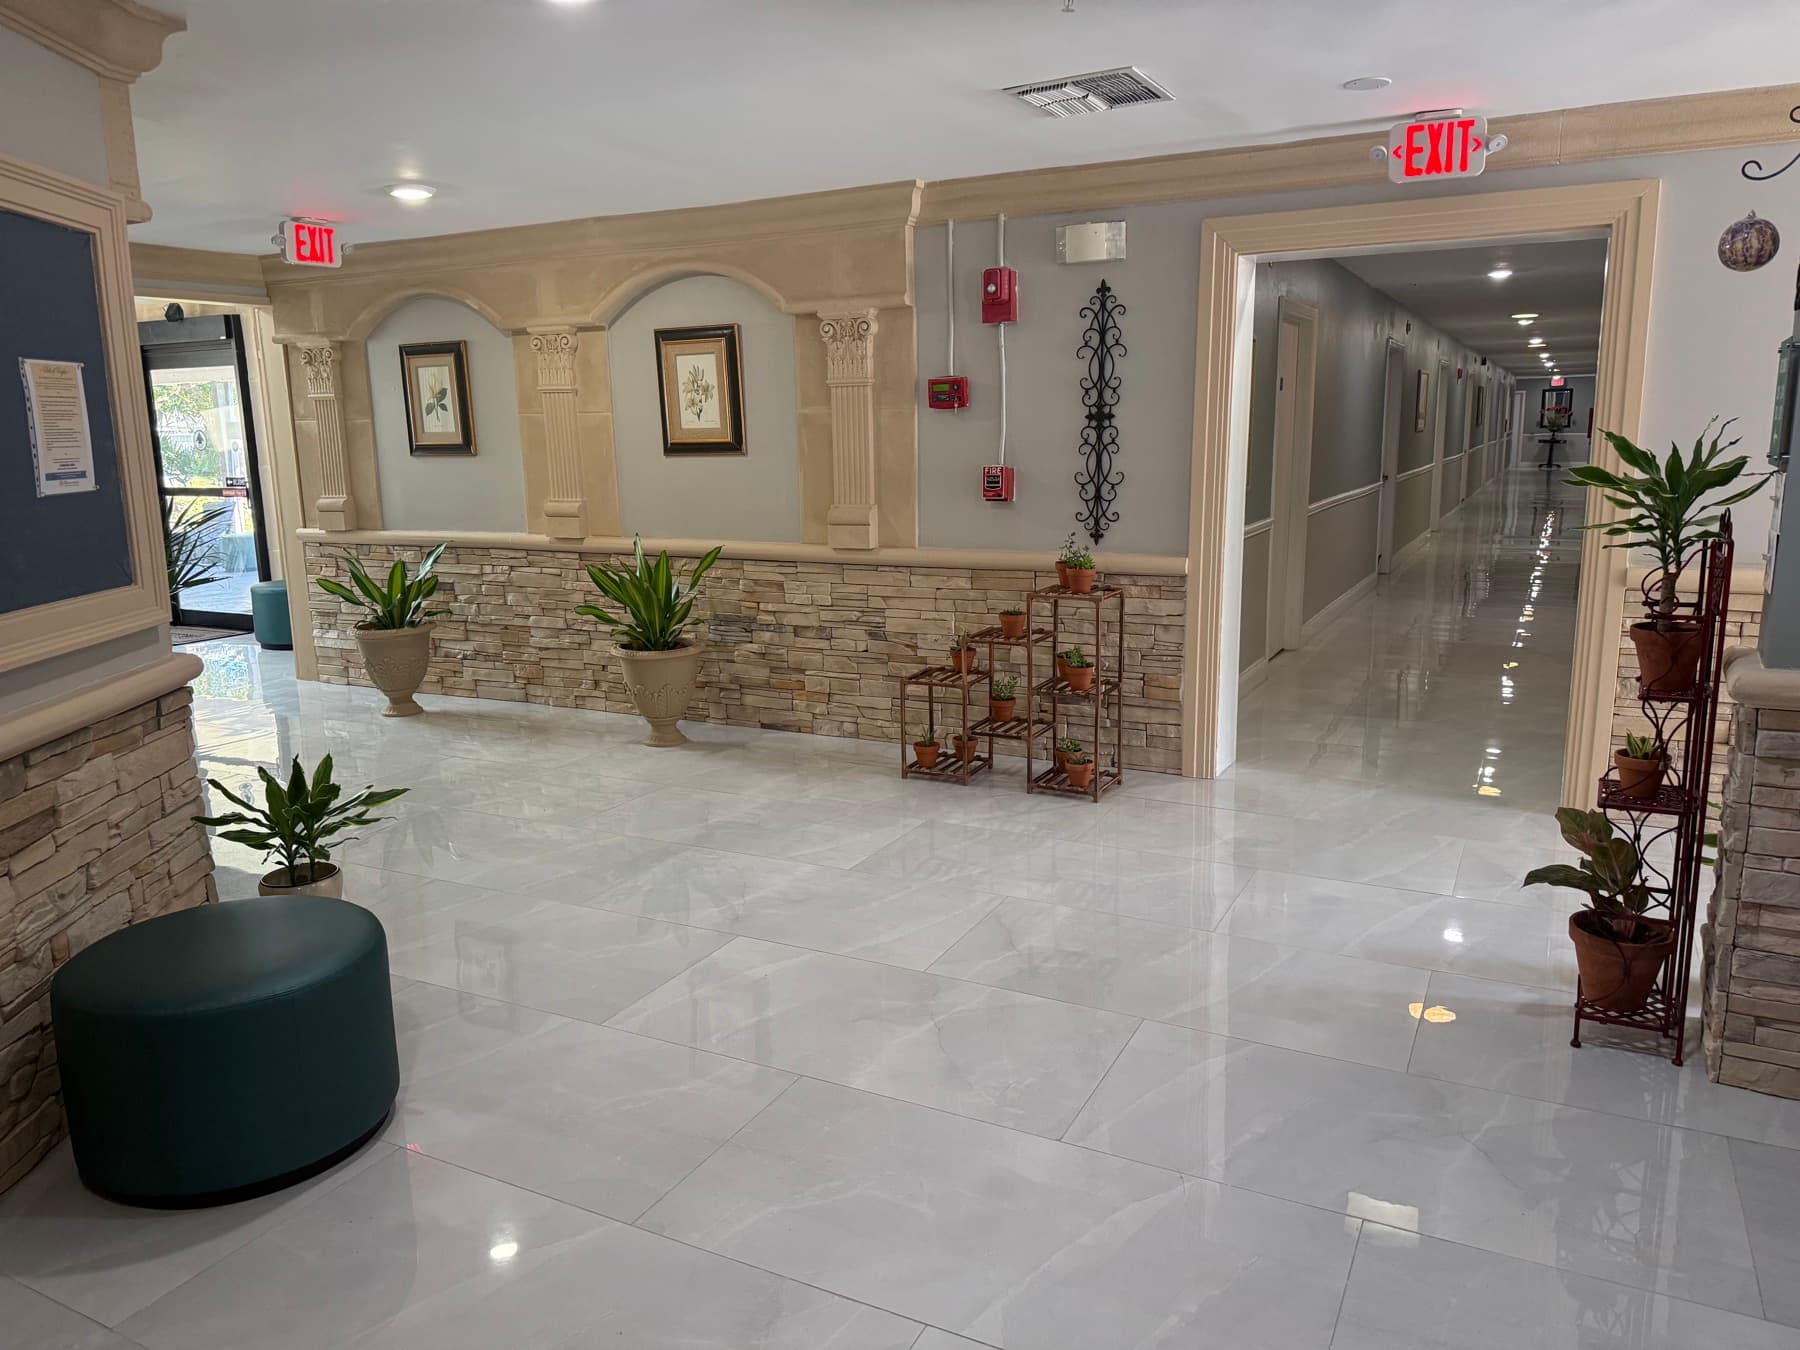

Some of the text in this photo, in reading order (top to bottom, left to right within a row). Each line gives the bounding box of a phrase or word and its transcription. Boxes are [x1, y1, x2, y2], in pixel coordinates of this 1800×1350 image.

[1405, 120, 1475, 176] EXIT
[295, 224, 334, 264] EXIT
[984, 467, 1002, 475] FIRE
